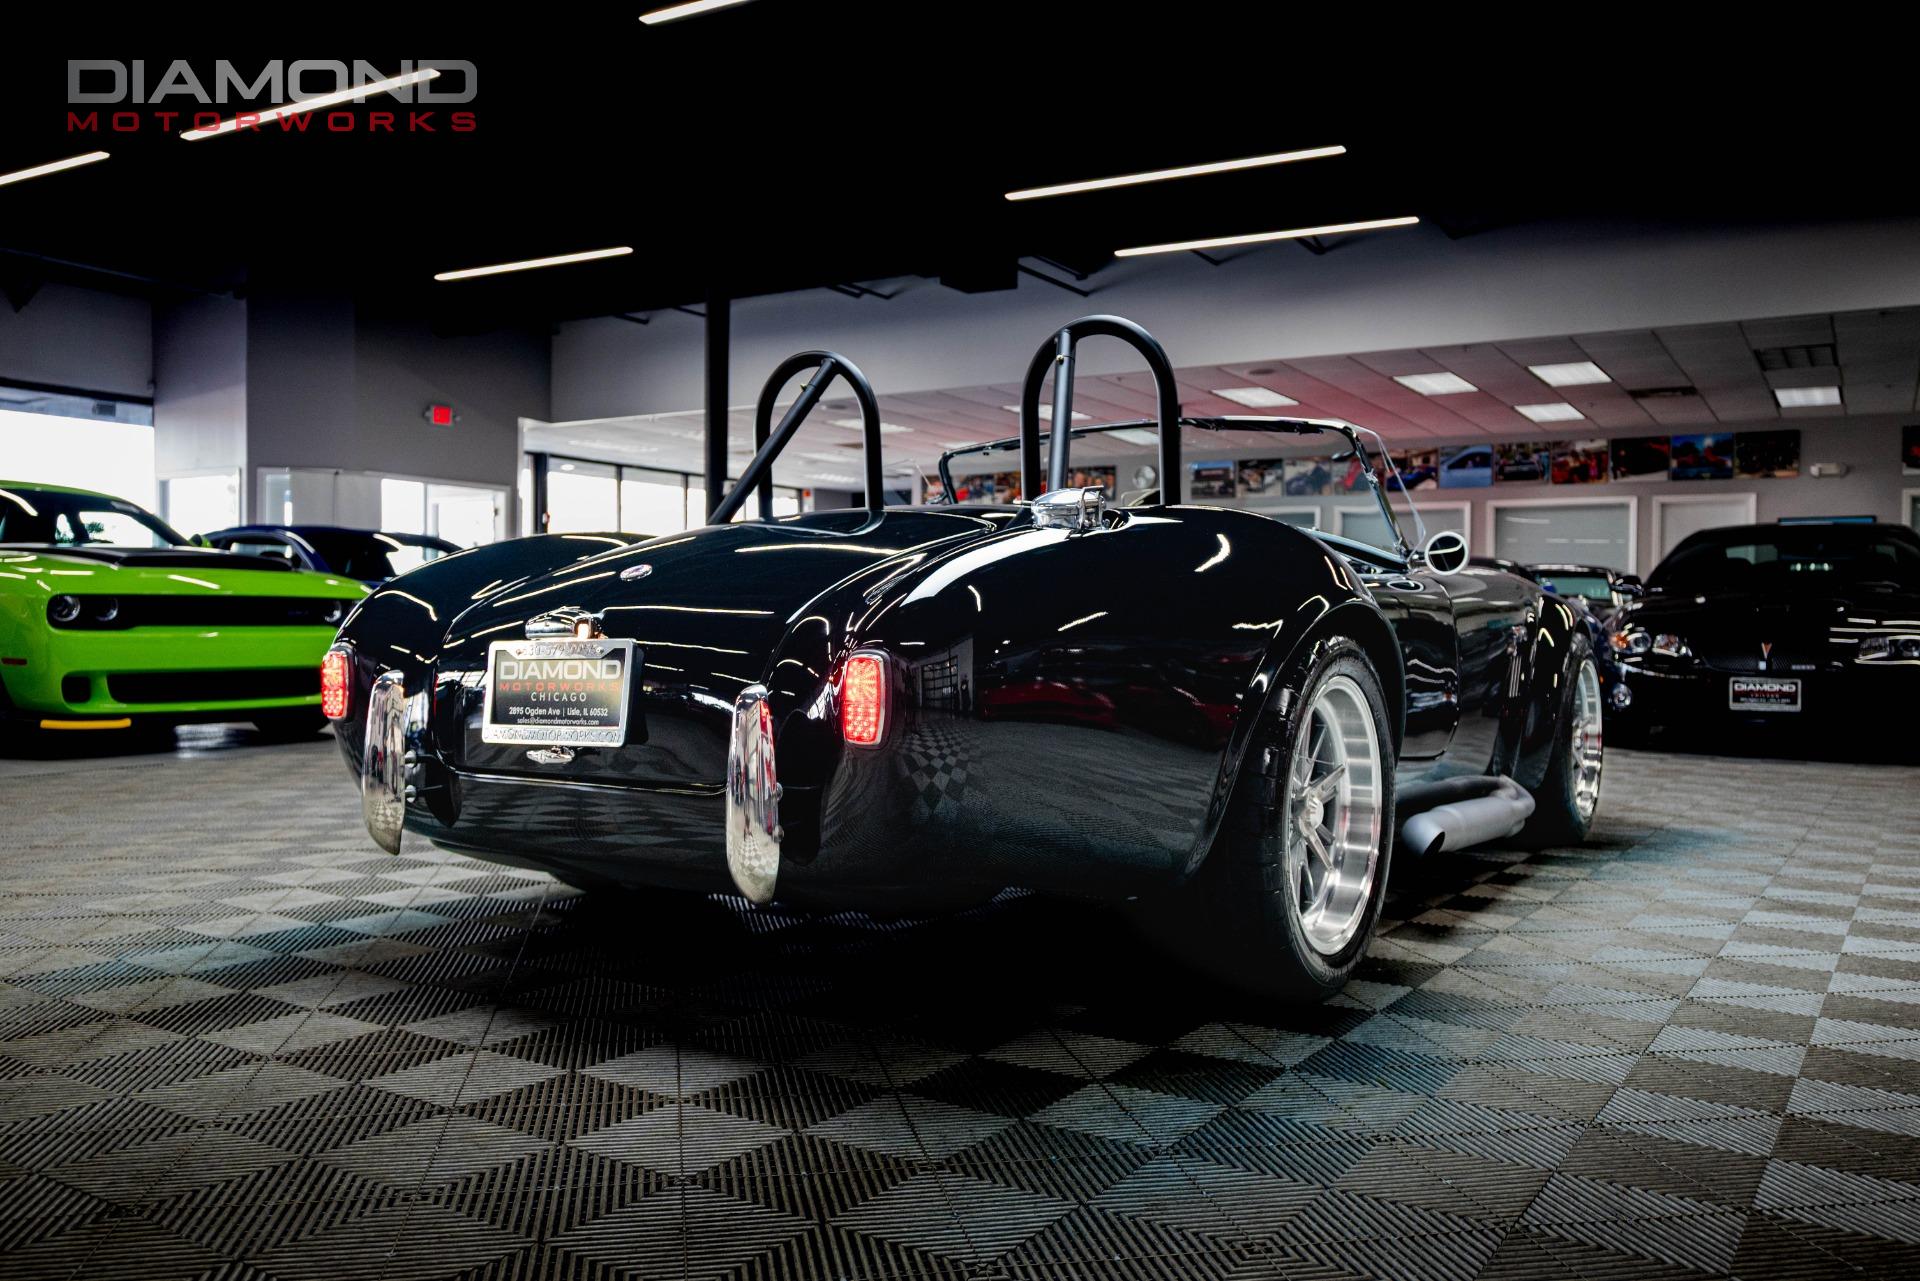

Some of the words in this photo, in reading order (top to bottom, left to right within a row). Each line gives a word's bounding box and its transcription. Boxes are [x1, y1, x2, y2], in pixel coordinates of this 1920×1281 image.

[499, 659, 622, 680] DIAMOND
[499, 681, 620, 693] MOTORWORKS
[1734, 682, 1796, 692] DIAMOND
[530, 692, 587, 702] CHICAGO
[508, 706, 524, 715] 2895
[524, 706, 547, 717] Ogden
[547, 707, 561, 716] Ave
[583, 707, 588, 716] IL
[589, 707, 609, 717] 60532
[517, 716, 600, 726] sales@diamondmotorworks.com
